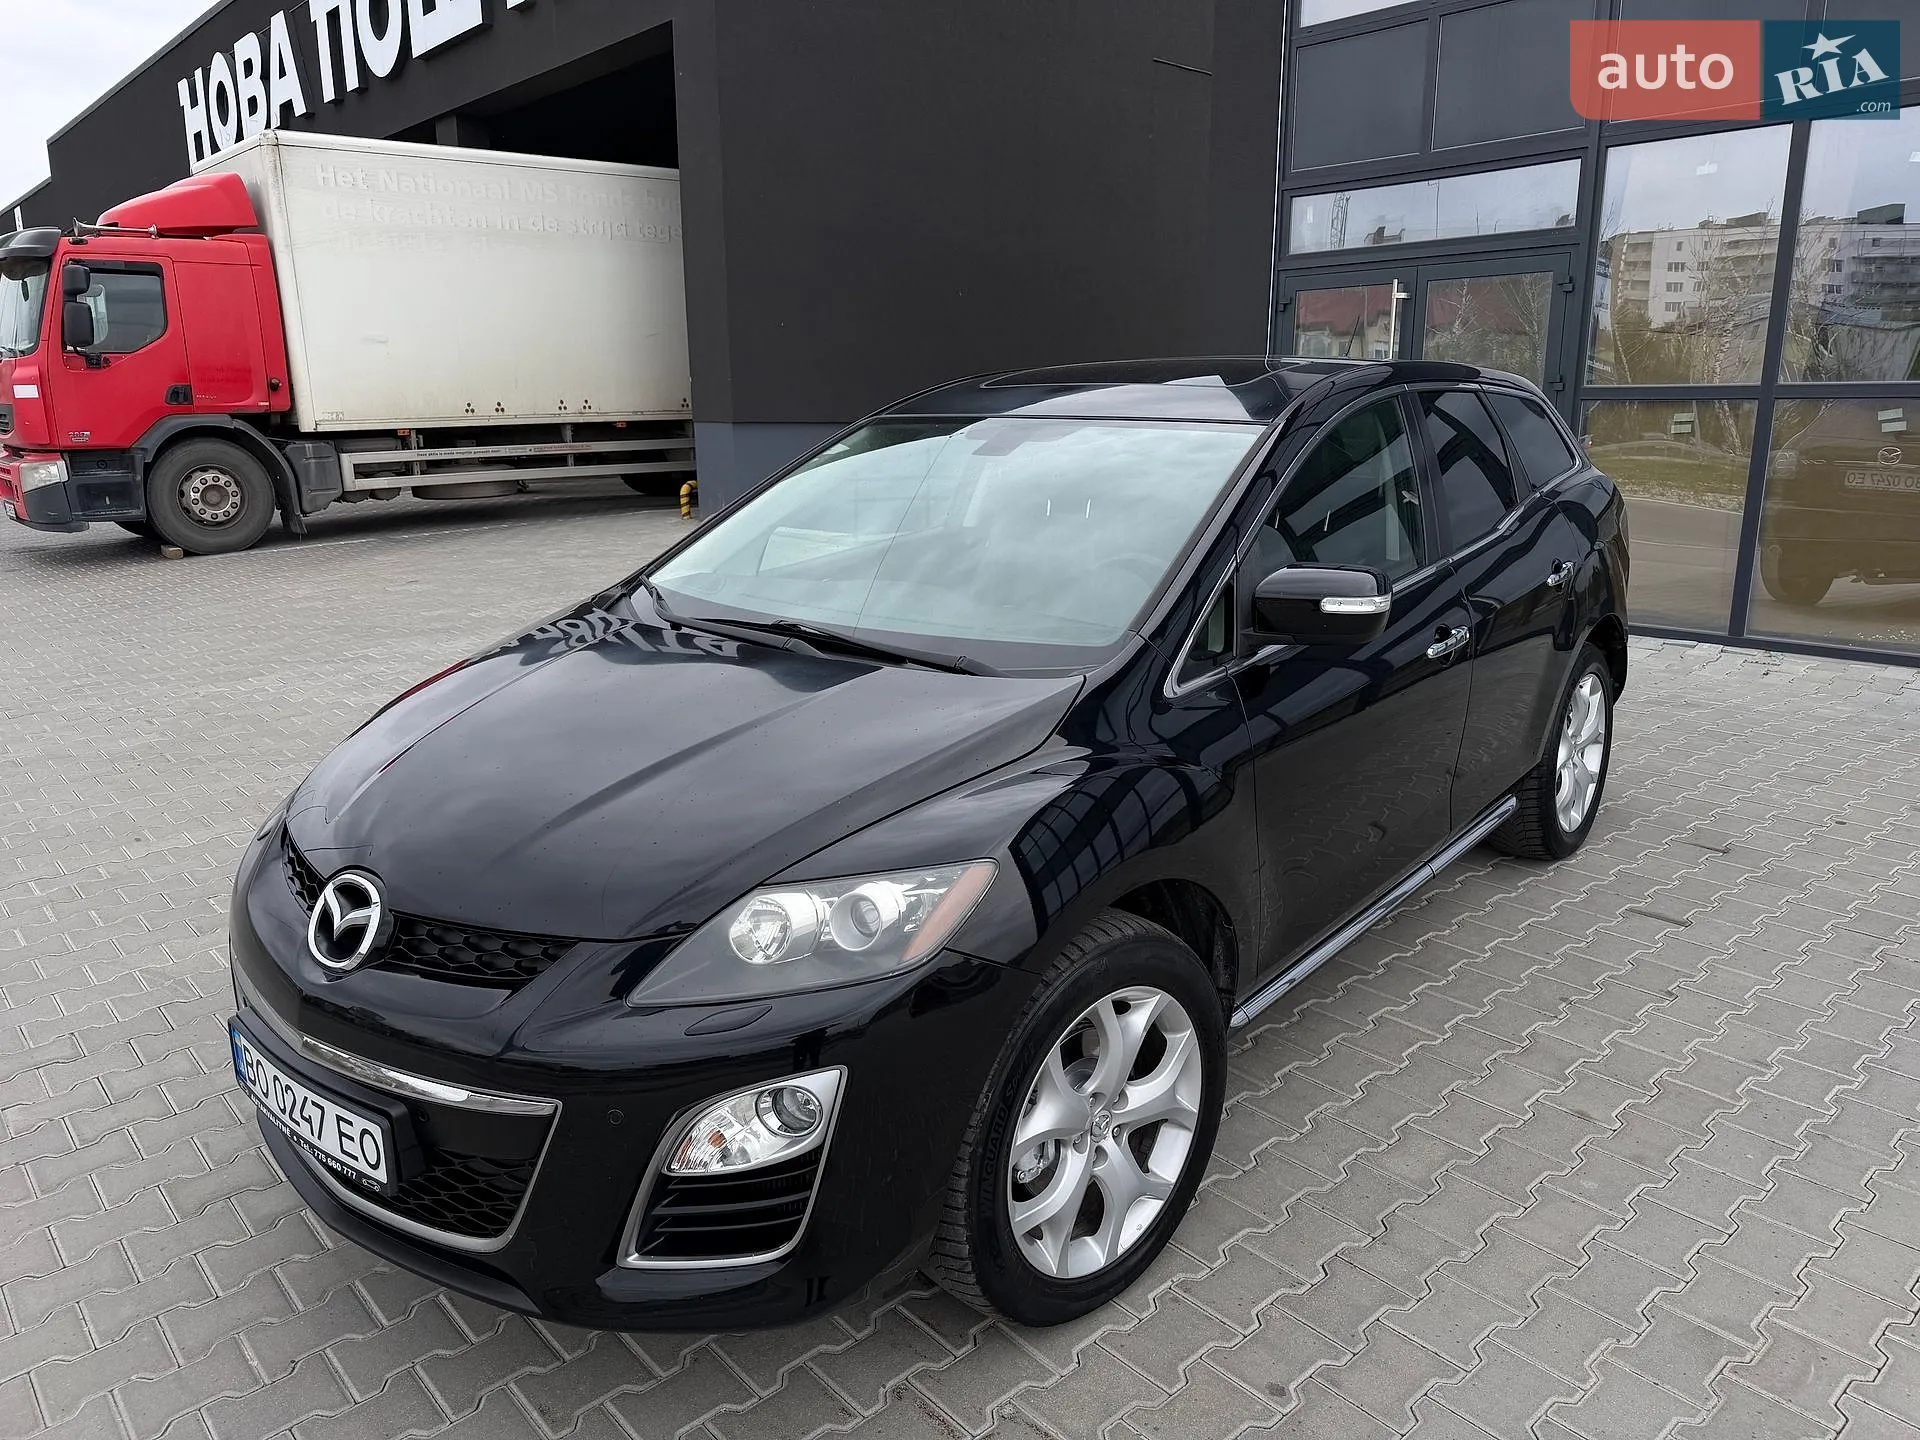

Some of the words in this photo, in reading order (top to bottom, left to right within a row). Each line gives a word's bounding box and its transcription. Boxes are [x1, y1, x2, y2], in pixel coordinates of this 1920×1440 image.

[177, 10, 307, 176] НОВА
[243, 1043, 269, 1100] BO
[273, 1074, 326, 1142] 0247
[335, 1113, 381, 1171] EO
[313, 1148, 326, 1163] 775
[342, 1165, 357, 1180] 777
